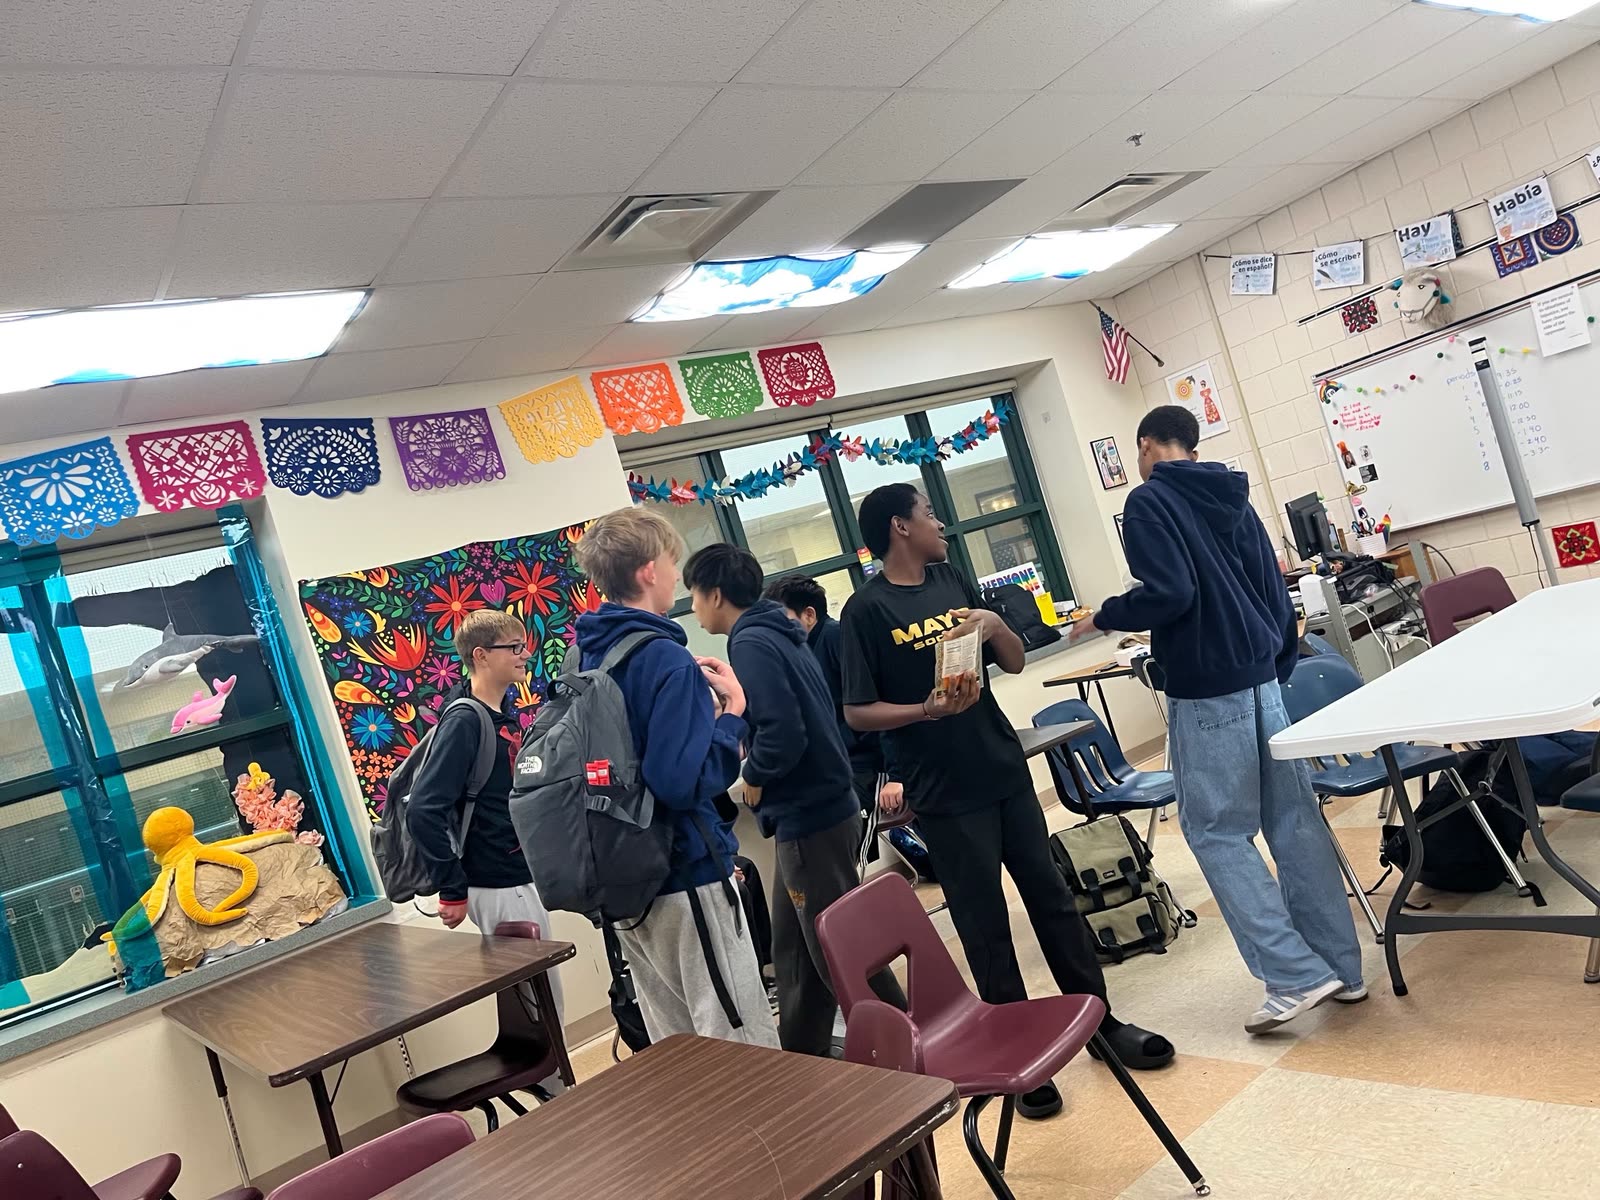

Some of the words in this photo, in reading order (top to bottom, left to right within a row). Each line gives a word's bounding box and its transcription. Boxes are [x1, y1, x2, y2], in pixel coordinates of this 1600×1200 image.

[1493, 184, 1542, 216] Había
[1399, 222, 1431, 242] Hay
[1315, 251, 1338, 262] ¿Cómo
[1330, 252, 1361, 266] escribe?
[1232, 260, 1252, 268] ¿Cómo
[1246, 262, 1274, 272] español?
[1446, 368, 1476, 385] periods
[1484, 461, 1490, 471] 8
